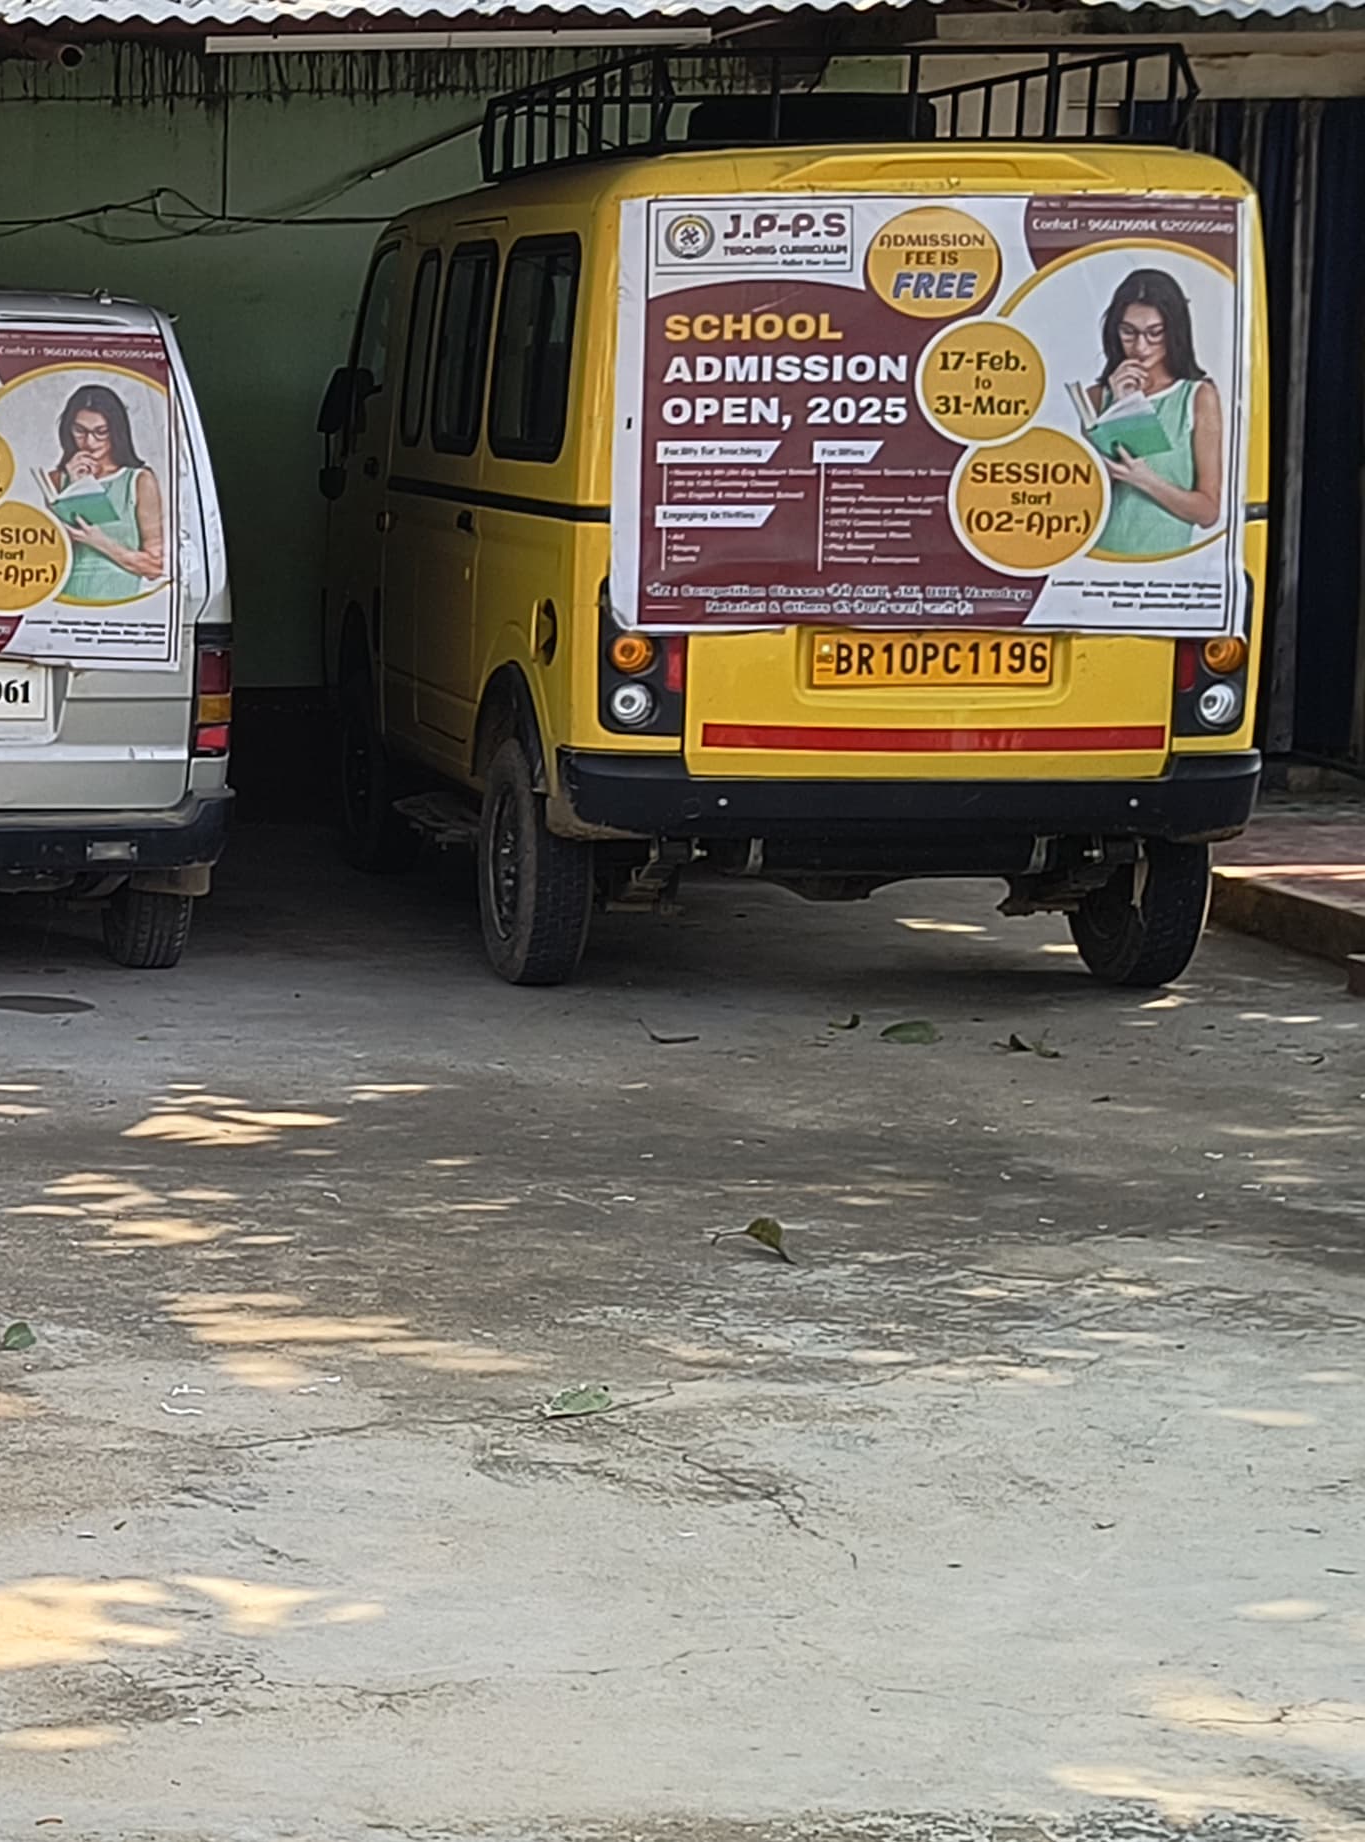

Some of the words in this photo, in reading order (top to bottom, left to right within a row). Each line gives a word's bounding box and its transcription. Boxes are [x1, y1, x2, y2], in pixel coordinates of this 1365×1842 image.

[722, 212, 846, 240] J.P-P.S
[1032, 218, 1079, 232] Contact
[879, 232, 985, 249] ADMISSION
[904, 251, 936, 266] FEE
[940, 250, 959, 266] IS
[891, 271, 979, 300] FREE
[664, 313, 844, 341] SCHOOL
[663, 354, 909, 383] ADMISSION
[938, 350, 1027, 372] 17-Feb.
[974, 375, 992, 390] to
[662, 396, 793, 431] OPEN,
[806, 396, 909, 425] 2025
[934, 395, 1030, 417] 31-Mar.
[970, 462, 1092, 485] SESSION
[1011, 491, 1052, 506] Start
[966, 507, 1092, 540] (02-Apr.)
[834, 641, 1049, 676] BR10PC1196
